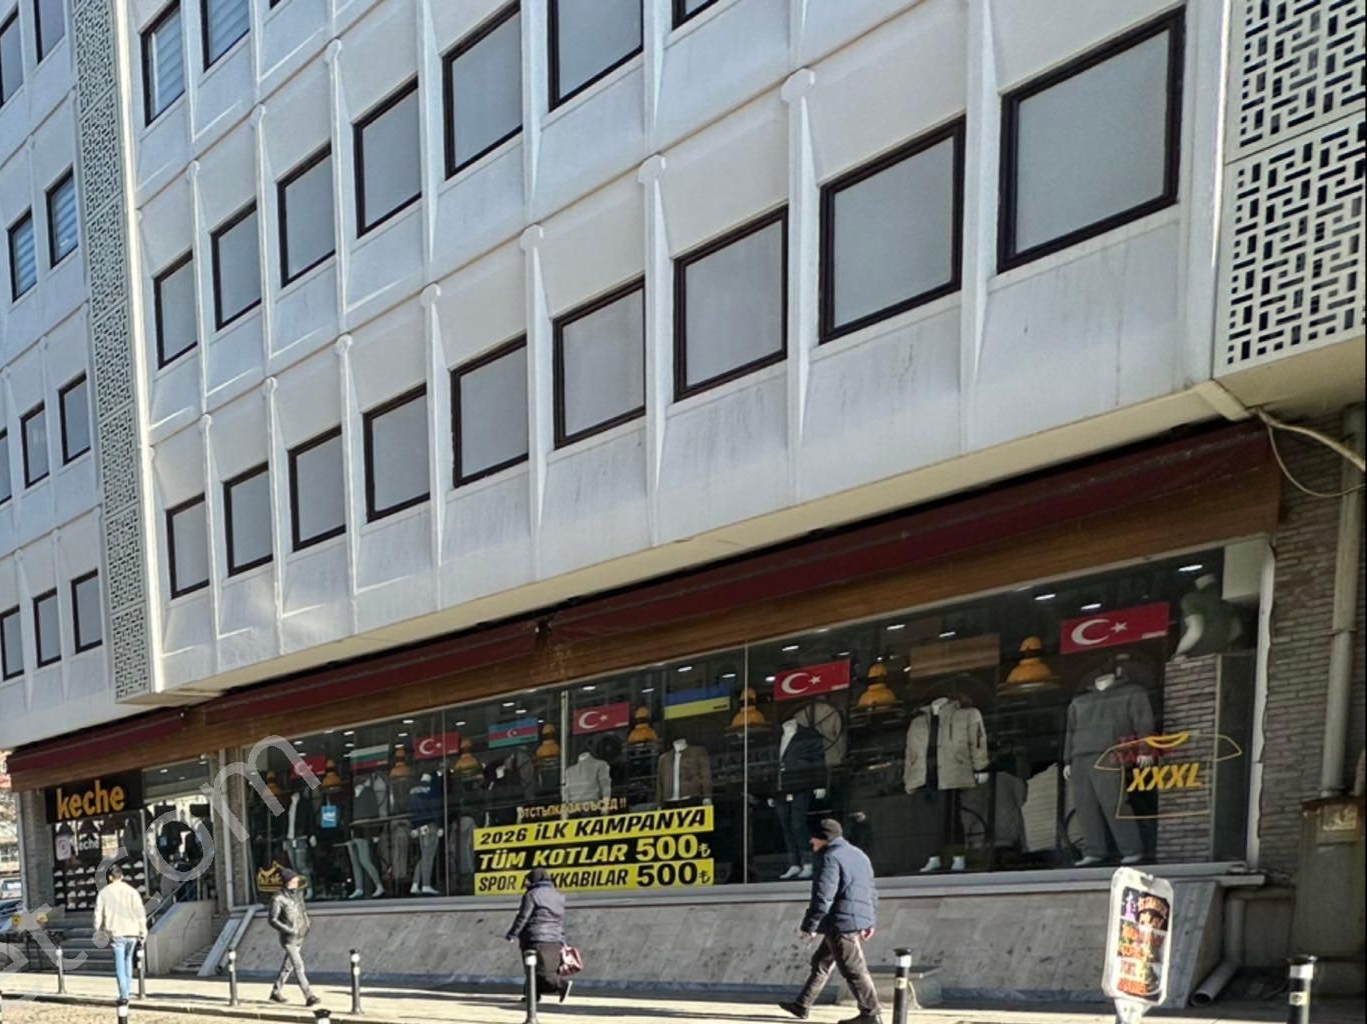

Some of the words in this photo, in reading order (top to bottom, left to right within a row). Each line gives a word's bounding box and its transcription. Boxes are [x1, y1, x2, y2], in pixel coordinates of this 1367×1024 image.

[1127, 762, 1203, 792] XXXL
[56, 779, 125, 820] keche
[480, 827, 528, 845] 2026
[575, 808, 706, 838] KAMPANYA
[479, 849, 526, 871] TÜM
[532, 844, 628, 867] KOTLAR
[479, 875, 517, 892] SPOR
